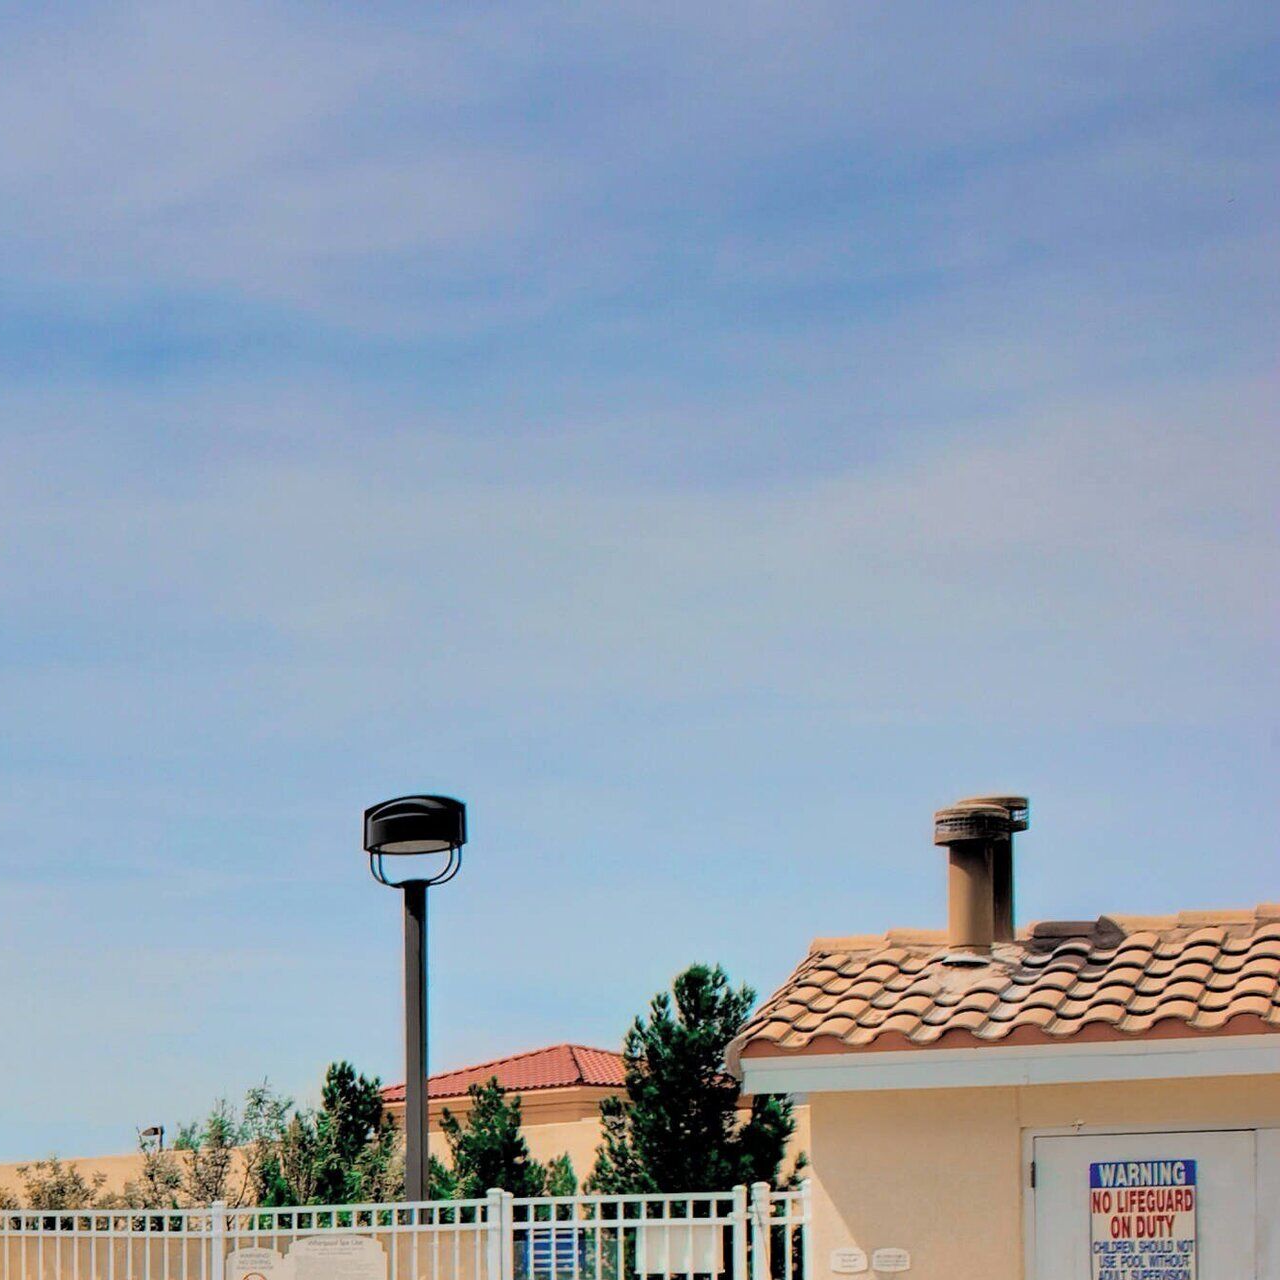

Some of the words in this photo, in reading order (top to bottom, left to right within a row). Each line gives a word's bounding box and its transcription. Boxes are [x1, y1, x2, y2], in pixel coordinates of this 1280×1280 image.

[1099, 1162, 1186, 1187] WARNING
[1092, 1191, 1112, 1214] NO
[1117, 1189, 1194, 1213] LIFEGUARD
[1110, 1215, 1130, 1239] ON
[1136, 1214, 1176, 1238] DUTY
[1093, 1240, 1135, 1254] CHILDREN
[1139, 1240, 1174, 1253] SHOULD
[1177, 1240, 1194, 1253] NOT
[1100, 1255, 1117, 1268] USE
[1121, 1255, 1145, 1268] POOL
[1149, 1254, 1190, 1268] WITHOUT
